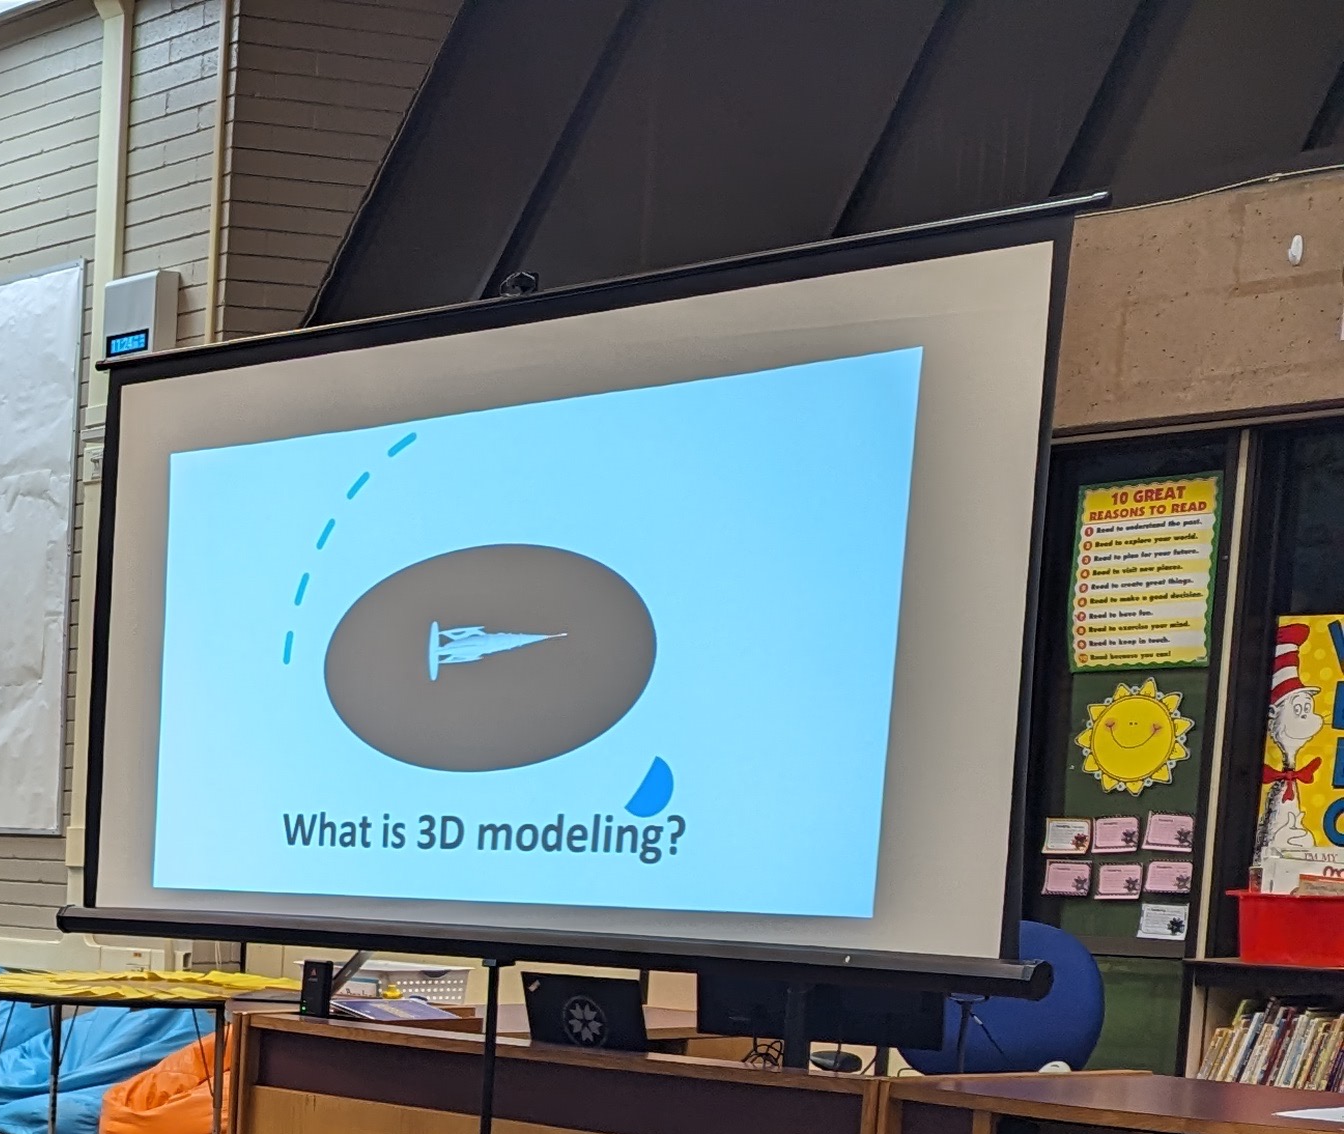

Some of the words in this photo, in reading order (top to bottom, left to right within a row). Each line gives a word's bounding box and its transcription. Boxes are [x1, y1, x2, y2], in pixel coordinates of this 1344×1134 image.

[1111, 492, 1128, 506] 10
[1133, 485, 1186, 504] GREAT
[1089, 506, 1146, 521] REASONS
[1149, 504, 1167, 516] TO
[1171, 501, 1207, 514] READ
[283, 812, 372, 849] What
[382, 814, 406, 850] is
[416, 815, 465, 850] 3D
[477, 814, 687, 865] modeling?
